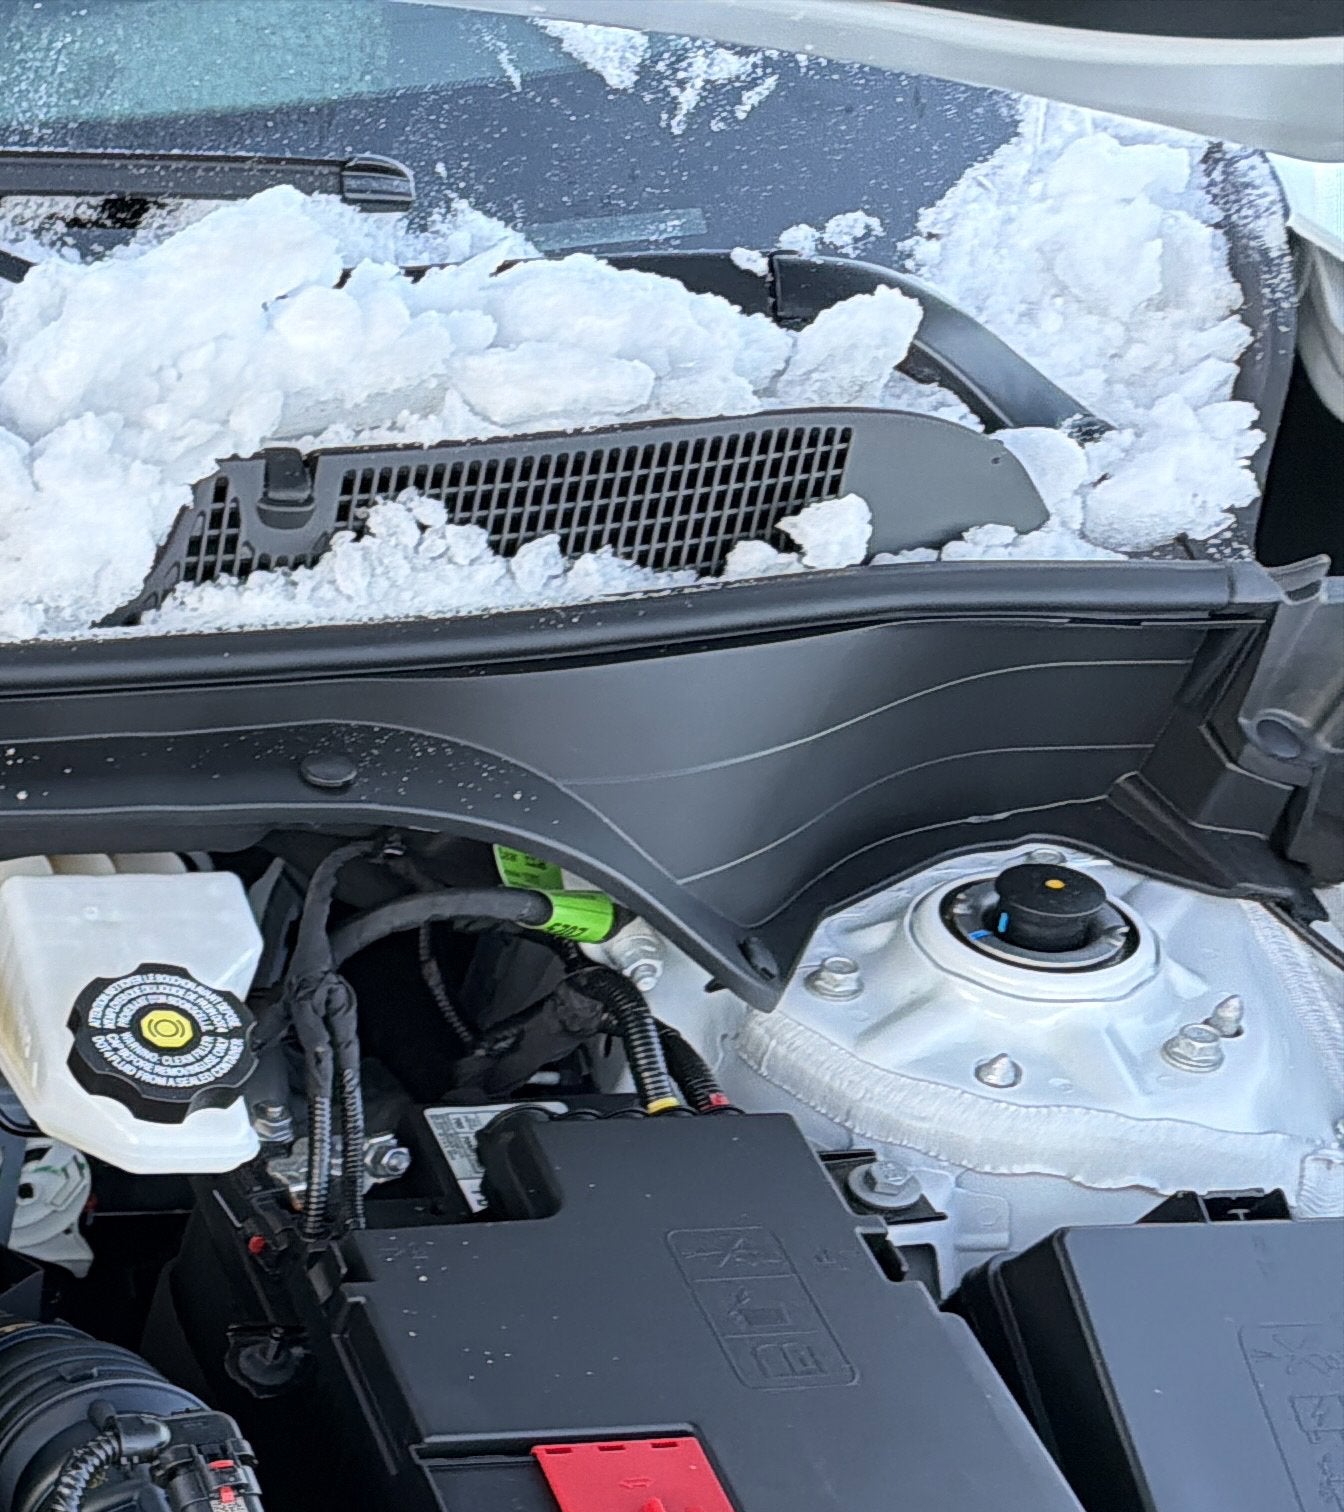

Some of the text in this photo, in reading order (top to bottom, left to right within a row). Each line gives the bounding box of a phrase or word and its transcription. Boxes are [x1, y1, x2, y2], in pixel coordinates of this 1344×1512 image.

[92, 1036, 111, 1052] DOT
[162, 1051, 196, 1066] CLEAN
[190, 1036, 216, 1059] FILLER
[101, 1049, 115, 1058] 4
[106, 1034, 124, 1051] CAP
[116, 1047, 154, 1072] BEFORE
[210, 1037, 229, 1057] ONLY
[106, 1054, 137, 1076] FLUID
[134, 1070, 165, 1084] FROM
[167, 1077, 176, 1086] A
[176, 1070, 215, 1088] SEALED
